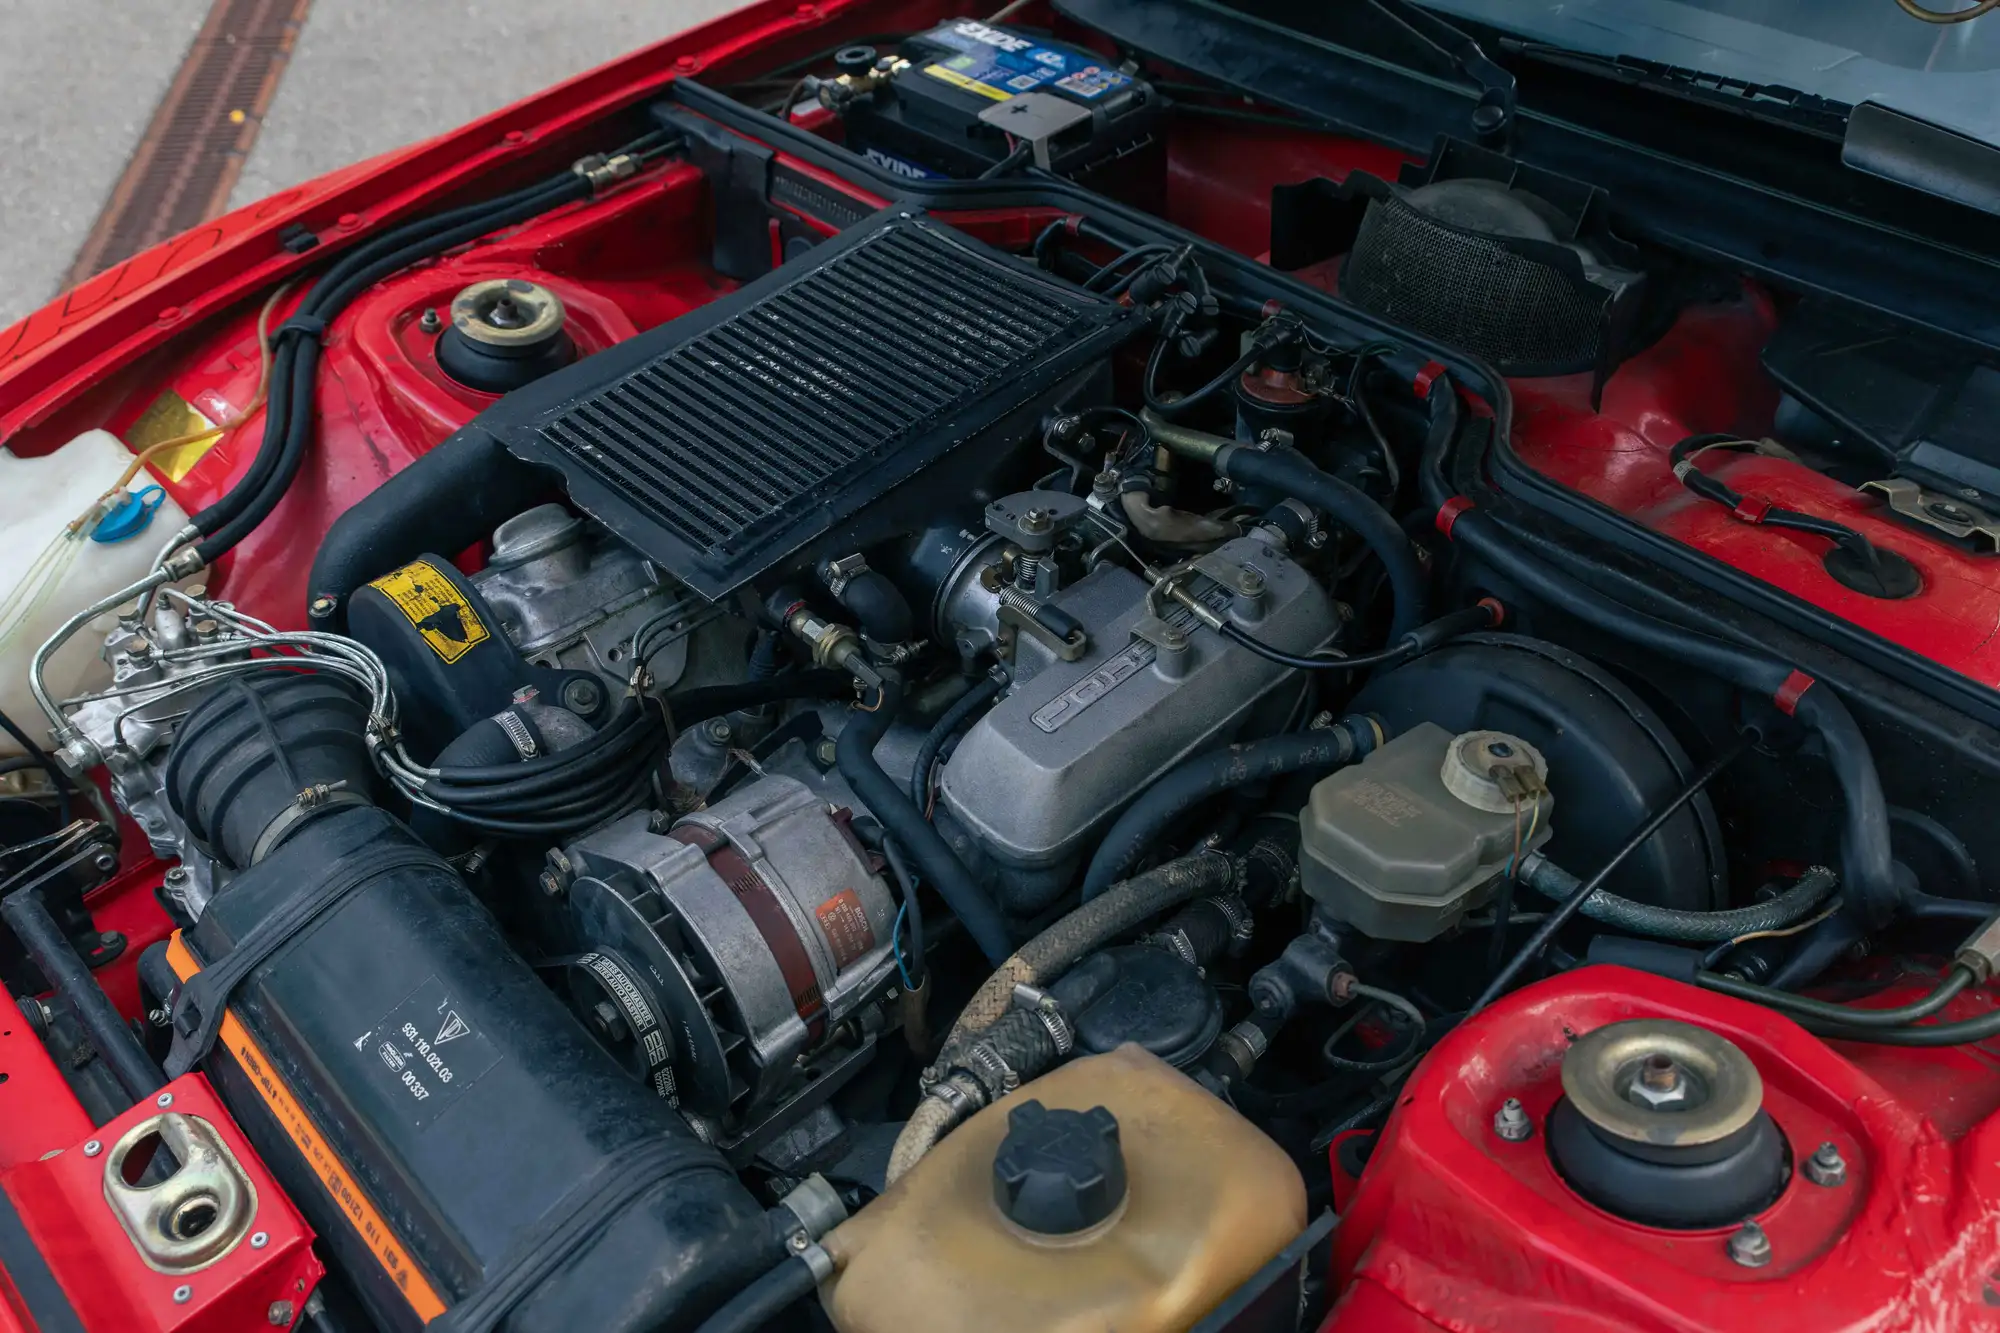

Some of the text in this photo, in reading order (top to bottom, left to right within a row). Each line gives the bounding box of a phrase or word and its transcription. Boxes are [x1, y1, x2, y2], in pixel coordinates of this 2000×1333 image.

[954, 21, 1034, 52] EXIDE
[855, 907, 869, 932] BOSCH
[595, 964, 643, 1026] GATES AUTO MASTER
[602, 960, 651, 1022] GATES AUTO MASTER
